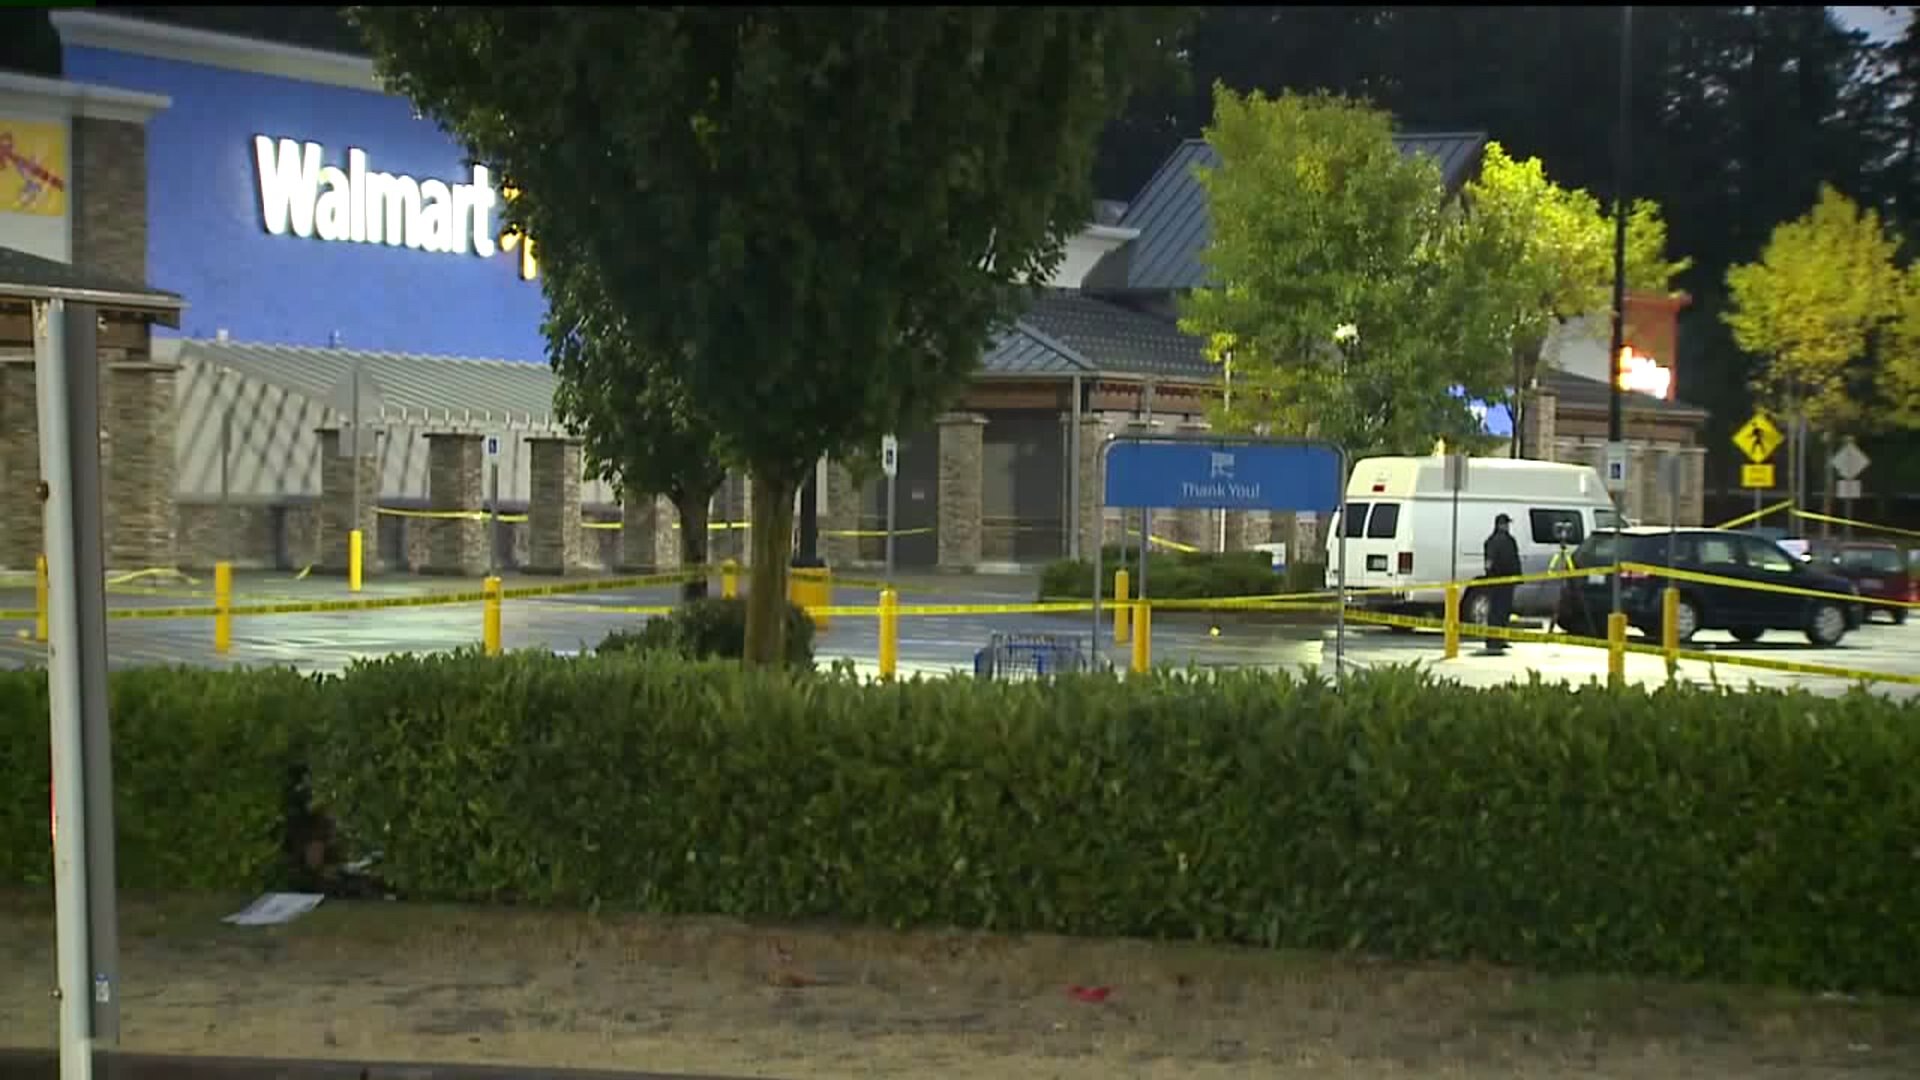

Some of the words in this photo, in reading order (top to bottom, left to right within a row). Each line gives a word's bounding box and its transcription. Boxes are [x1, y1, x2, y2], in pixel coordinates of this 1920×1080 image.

[254, 134, 495, 258] Walmart
[1181, 482, 1226, 499] Thank
[1227, 482, 1261, 499] You!
